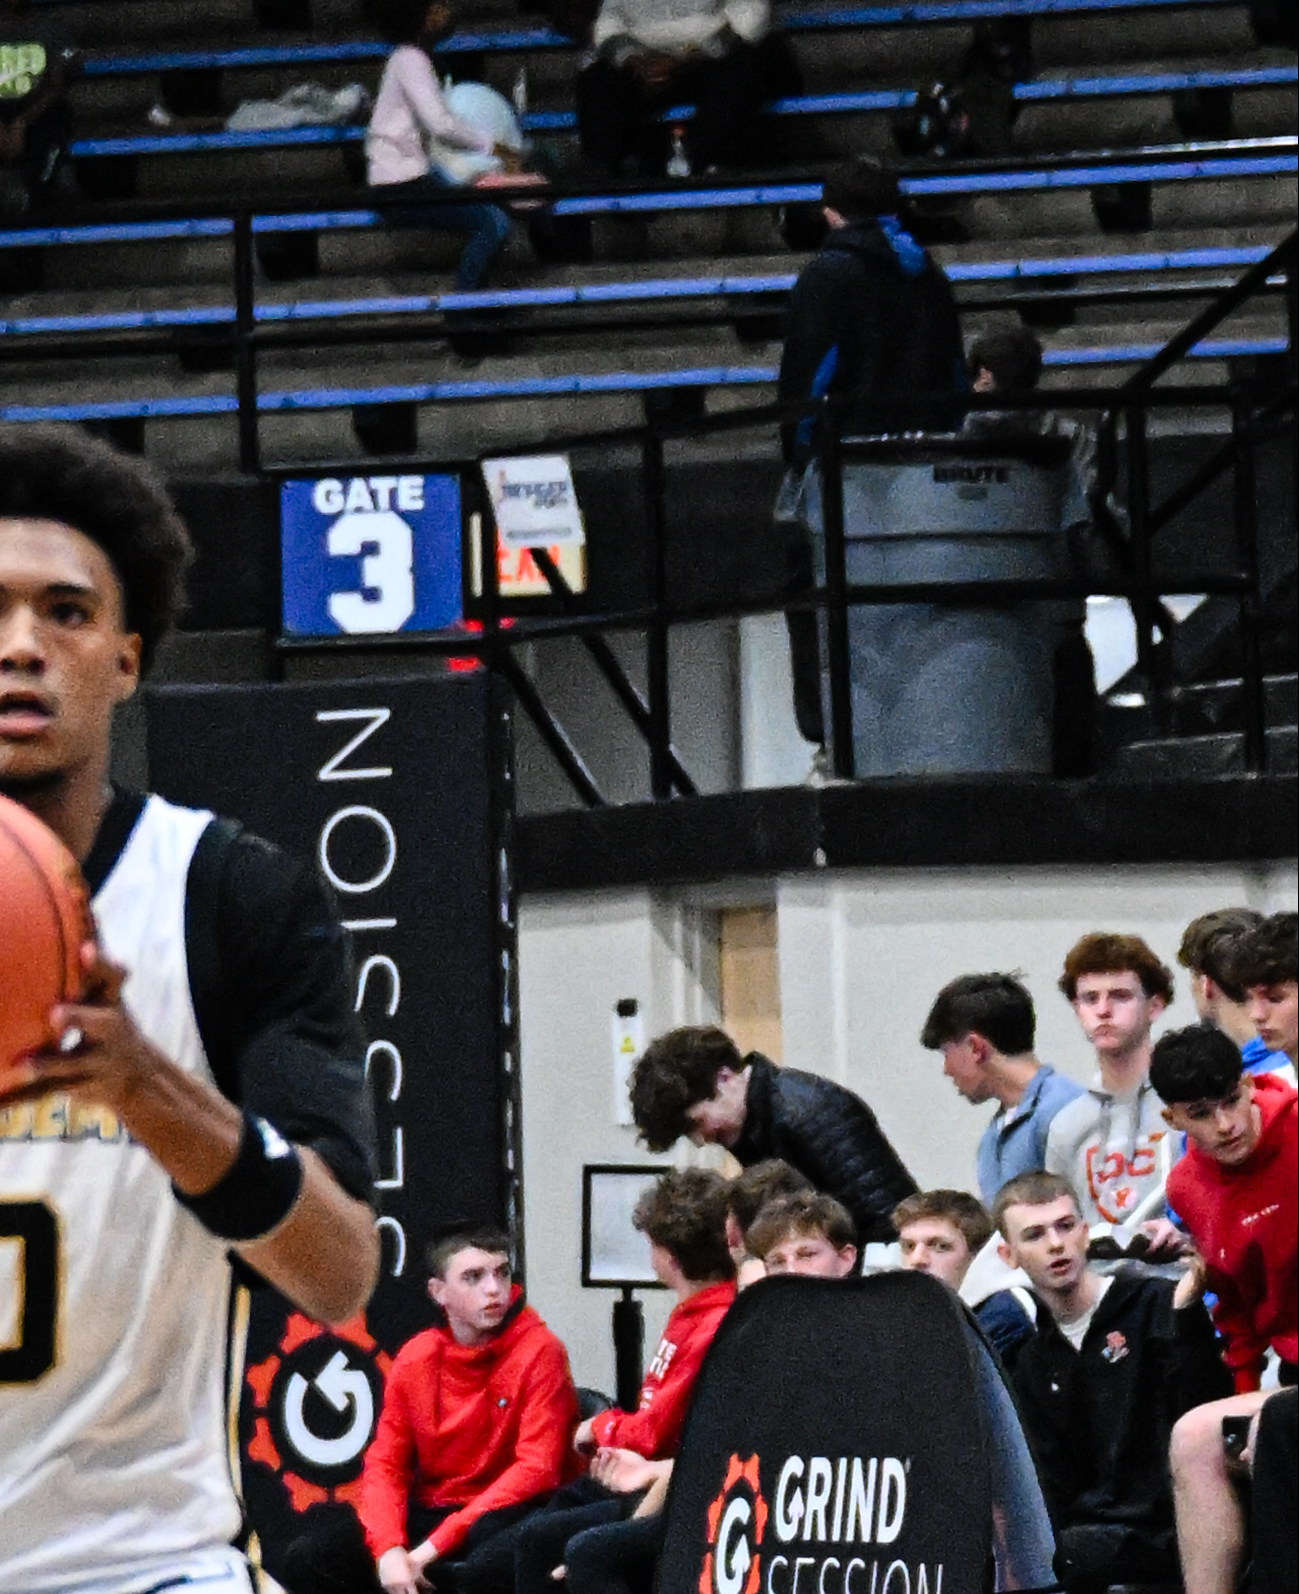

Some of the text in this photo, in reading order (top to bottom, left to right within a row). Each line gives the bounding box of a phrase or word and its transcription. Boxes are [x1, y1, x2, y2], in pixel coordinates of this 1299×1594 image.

[313, 474, 425, 515] GATE
[327, 512, 415, 635] 3
[774, 1455, 907, 1544] GRIND
